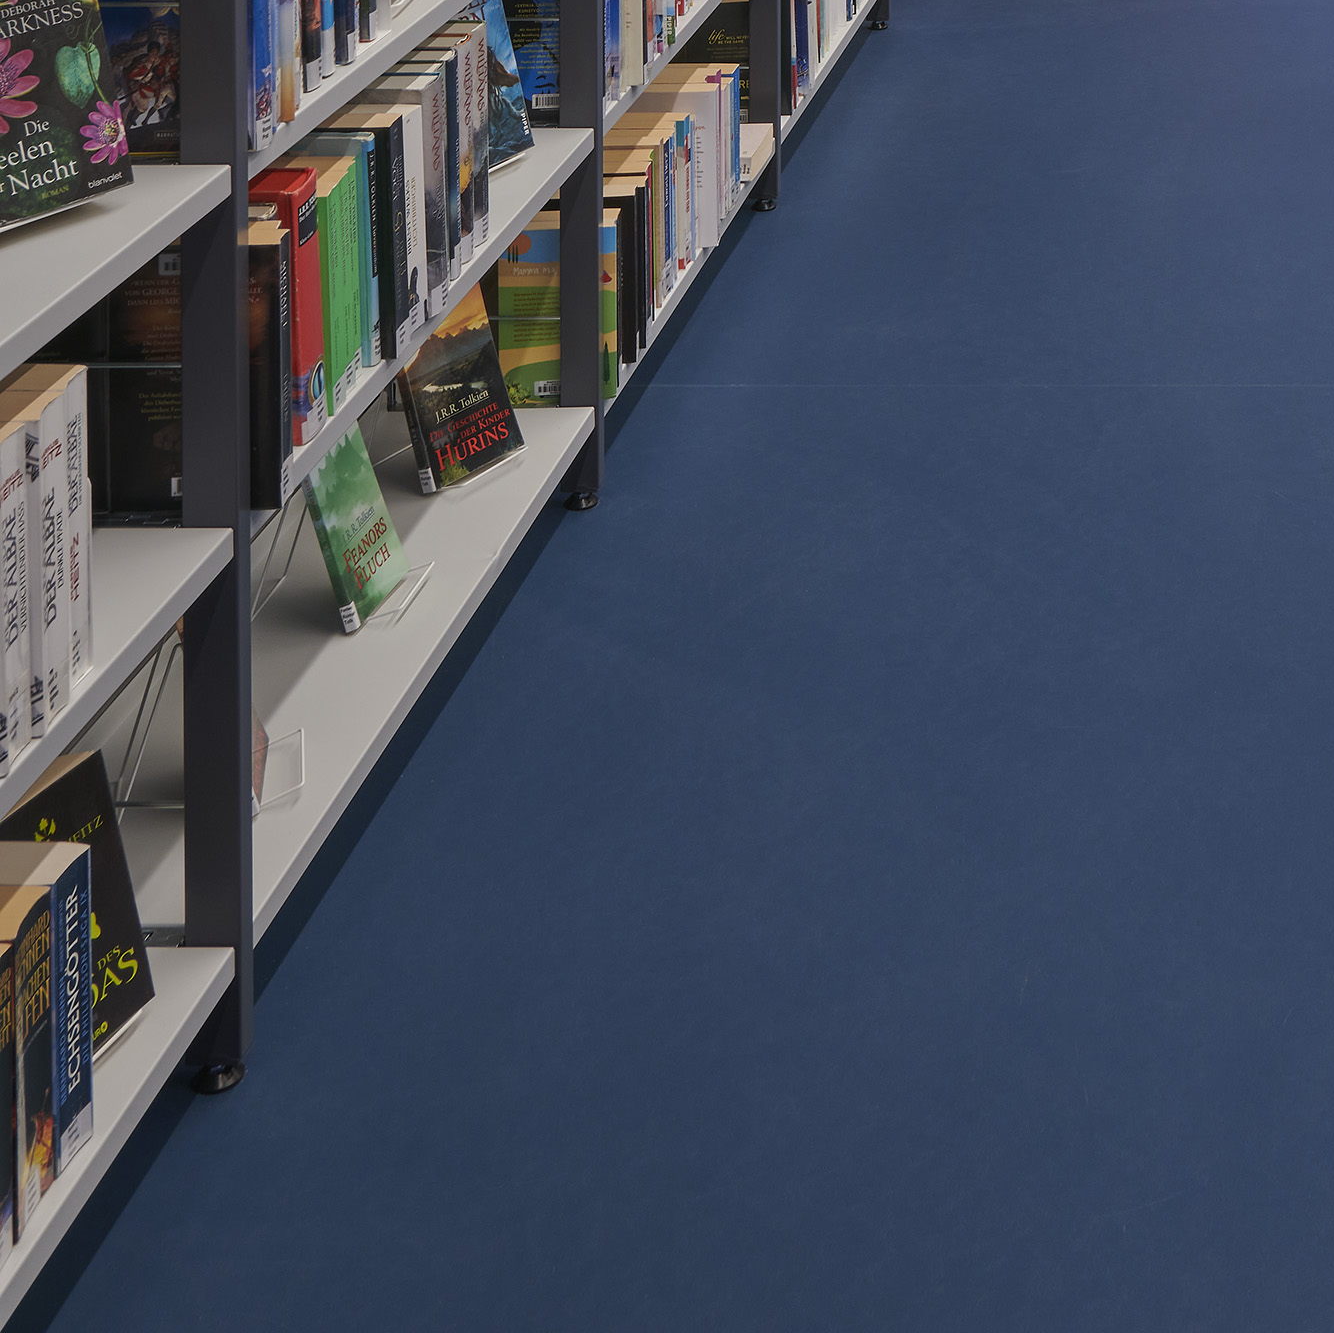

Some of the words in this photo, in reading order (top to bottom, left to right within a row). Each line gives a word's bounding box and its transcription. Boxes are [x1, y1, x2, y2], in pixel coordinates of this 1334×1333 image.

[24, 120, 50, 137] Die
[520, 112, 530, 135] PIPER
[7, 159, 80, 196] Nacht
[41, 185, 69, 199] ROMAN
[87, 172, 123, 189] blanvalet
[435, 404, 459, 424] J.R.R.
[458, 389, 490, 410] Tolkien
[460, 424, 477, 439] DER
[478, 408, 511, 430] KINDER
[435, 422, 510, 472] HÚRINS
[342, 517, 388, 572] FEANORS
[353, 542, 391, 590] FLUCH
[65, 884, 81, 1095] ECHSENGÖTTER
